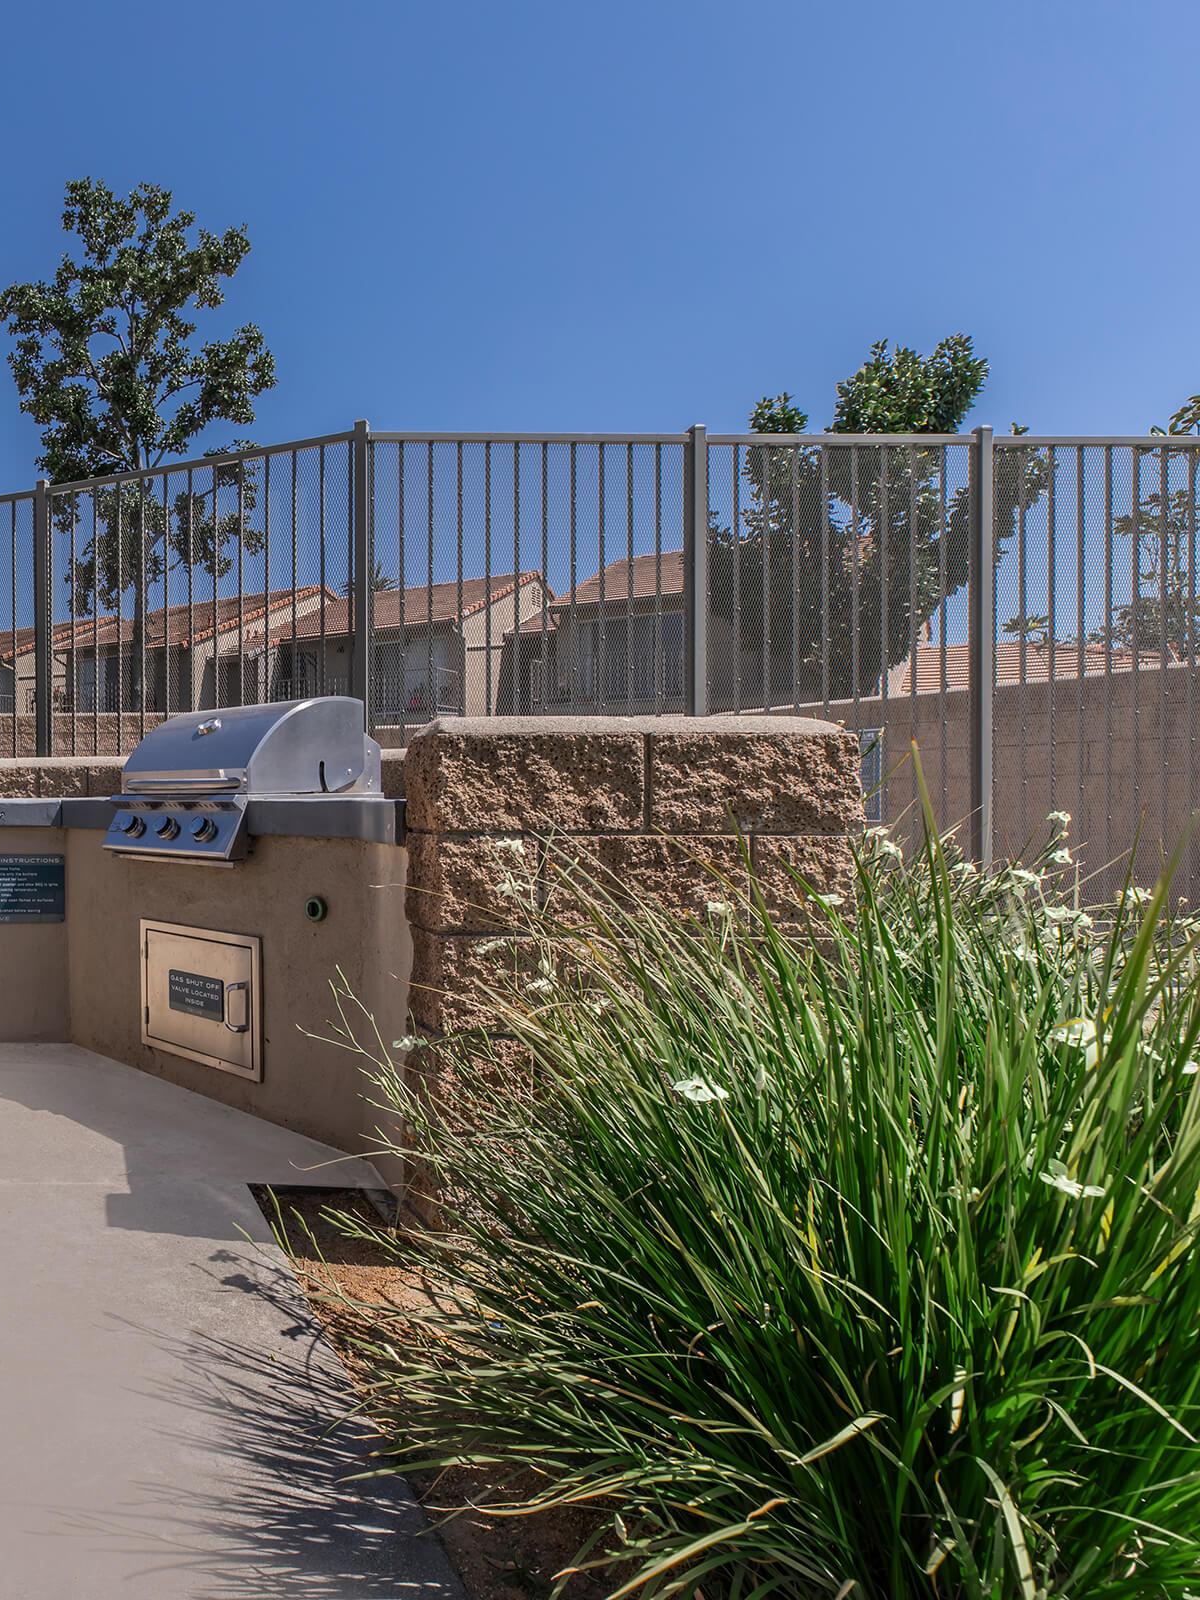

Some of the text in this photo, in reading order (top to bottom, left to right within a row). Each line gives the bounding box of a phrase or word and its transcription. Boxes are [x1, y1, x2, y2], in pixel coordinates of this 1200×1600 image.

[170, 974, 220, 990] GAS SHUT OFF
[170, 984, 220, 1001] VALVE LOCATED
[184, 997, 205, 1007] INSIDE
